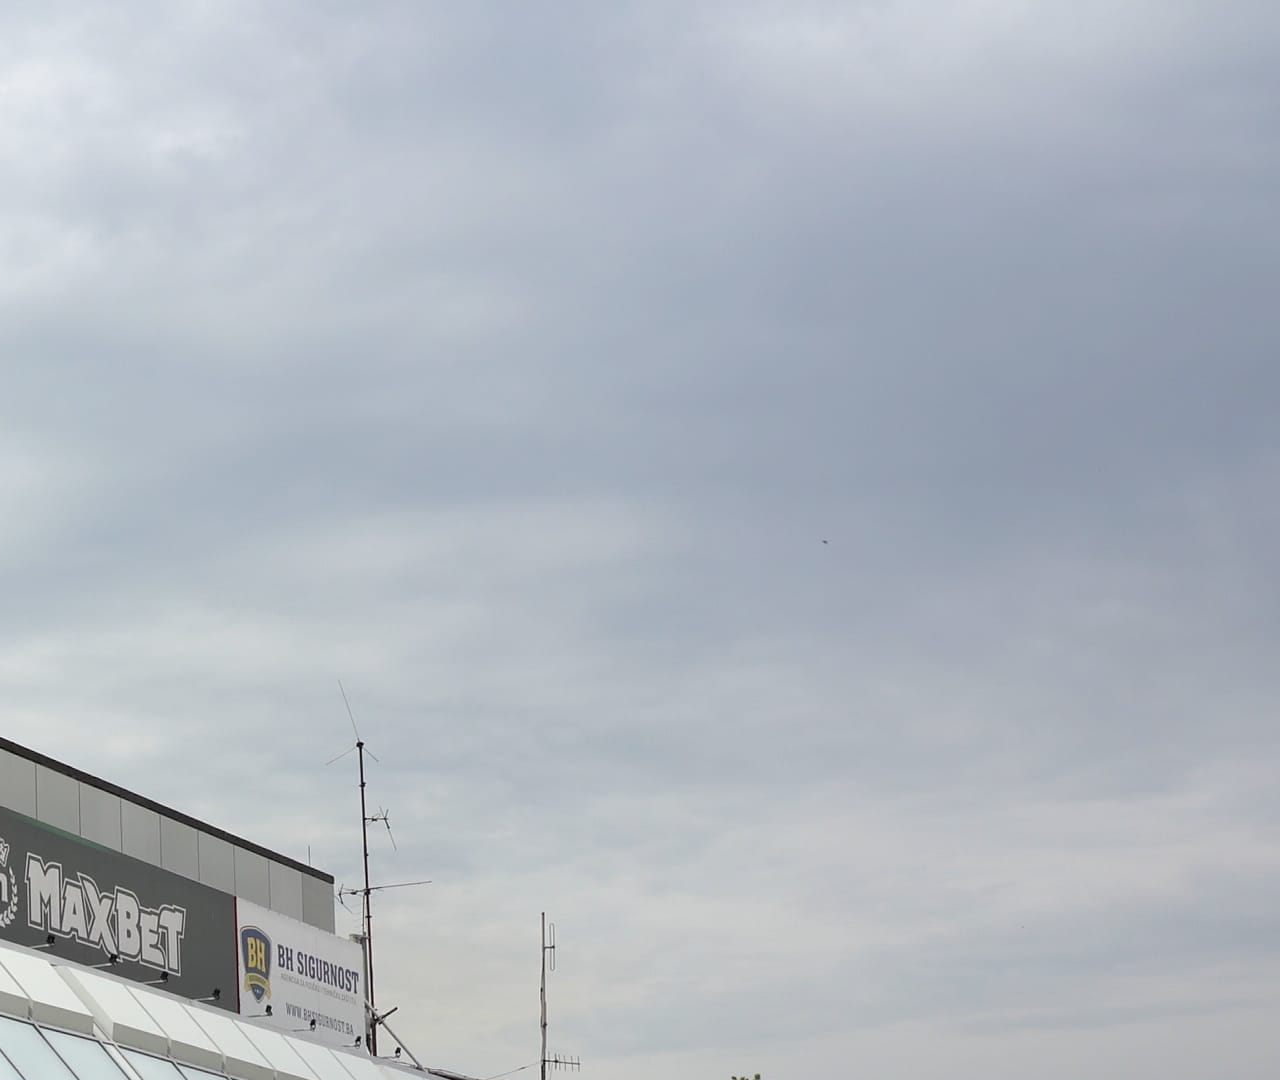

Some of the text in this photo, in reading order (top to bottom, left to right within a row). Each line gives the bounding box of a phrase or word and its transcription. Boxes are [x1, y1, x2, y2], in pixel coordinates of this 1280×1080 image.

[247, 936, 266, 973] BH
[277, 943, 359, 994] BH SIGURNOST
